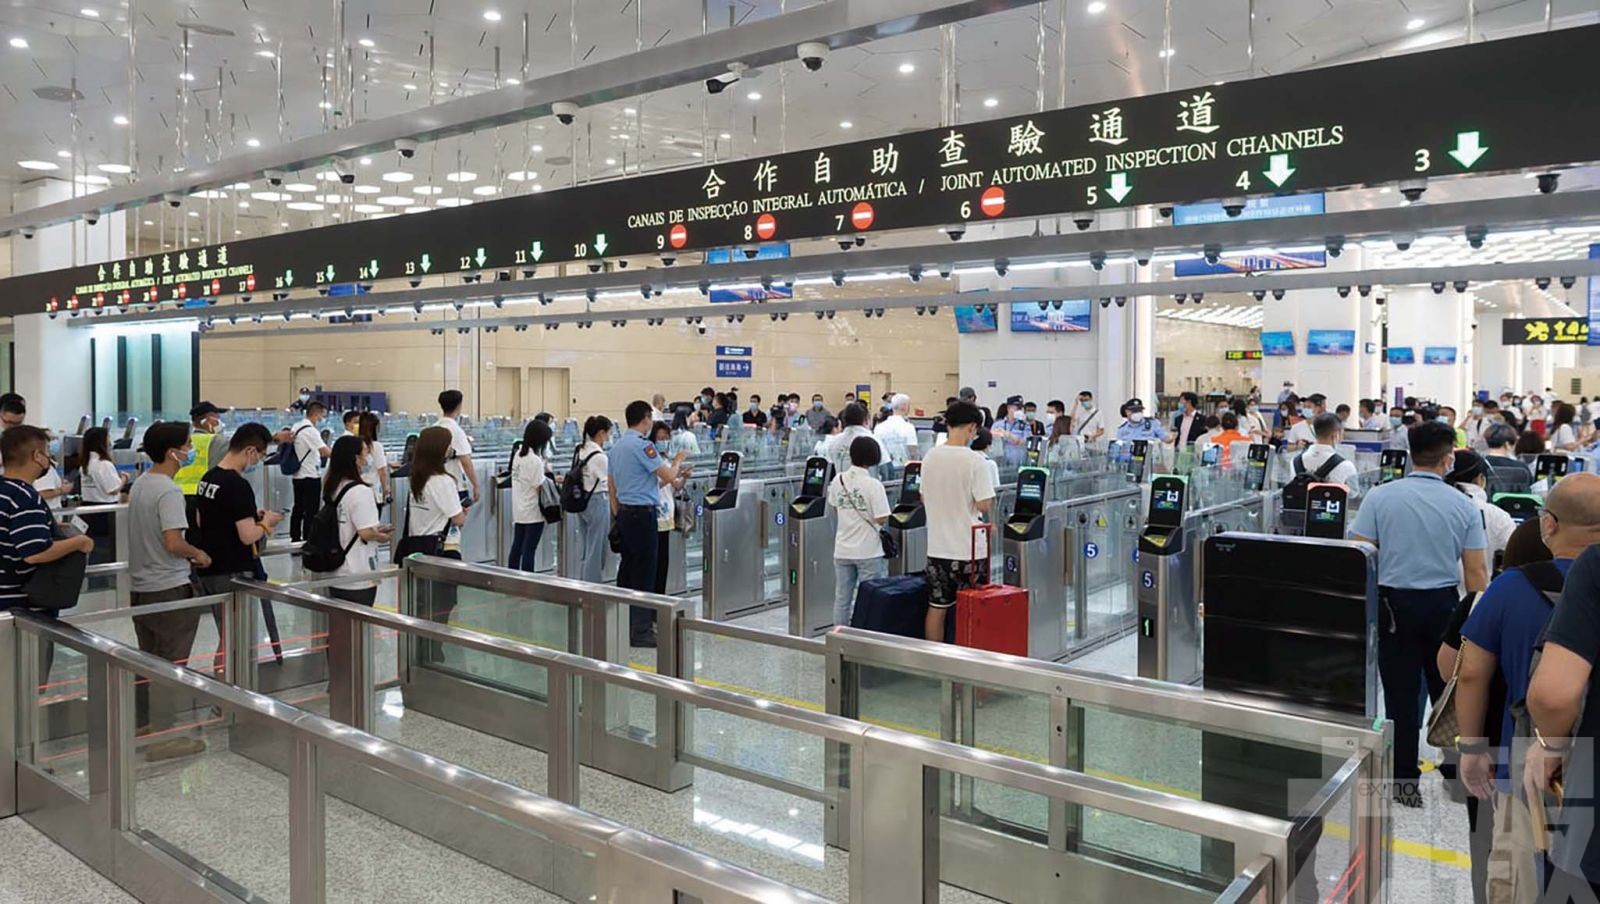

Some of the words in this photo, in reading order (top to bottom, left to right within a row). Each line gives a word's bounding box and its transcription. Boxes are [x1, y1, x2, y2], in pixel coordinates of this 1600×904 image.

[1415, 149, 1430, 171] 3
[628, 212, 665, 228] CANAIS
[669, 209, 684, 224] DE
[688, 200, 748, 221] INSPECÇÃO
[753, 193, 812, 214] INTEGRAL
[818, 180, 907, 206] AUTOMÁTICA
[918, 178, 925, 195] /
[940, 171, 984, 192] JOINT
[990, 157, 1098, 188] AUTOMATED
[1105, 142, 1217, 173] INSPECTION
[1226, 125, 1344, 156] CHANNELS
[1236, 171, 1250, 190] 4
[1087, 186, 1098, 205] 5
[961, 201, 971, 219] 6
[836, 214, 844, 230] 7
[744, 225, 752, 240] 8
[657, 235, 664, 249] 9
[515, 250, 526, 263] 11
[574, 243, 587, 257] 10
[405, 262, 415, 274] 13
[460, 257, 471, 269] 12
[316, 271, 325, 283] 15
[359, 267, 368, 279] 14
[1086, 544, 1096, 558] 5
[1144, 572, 1152, 588] 5
